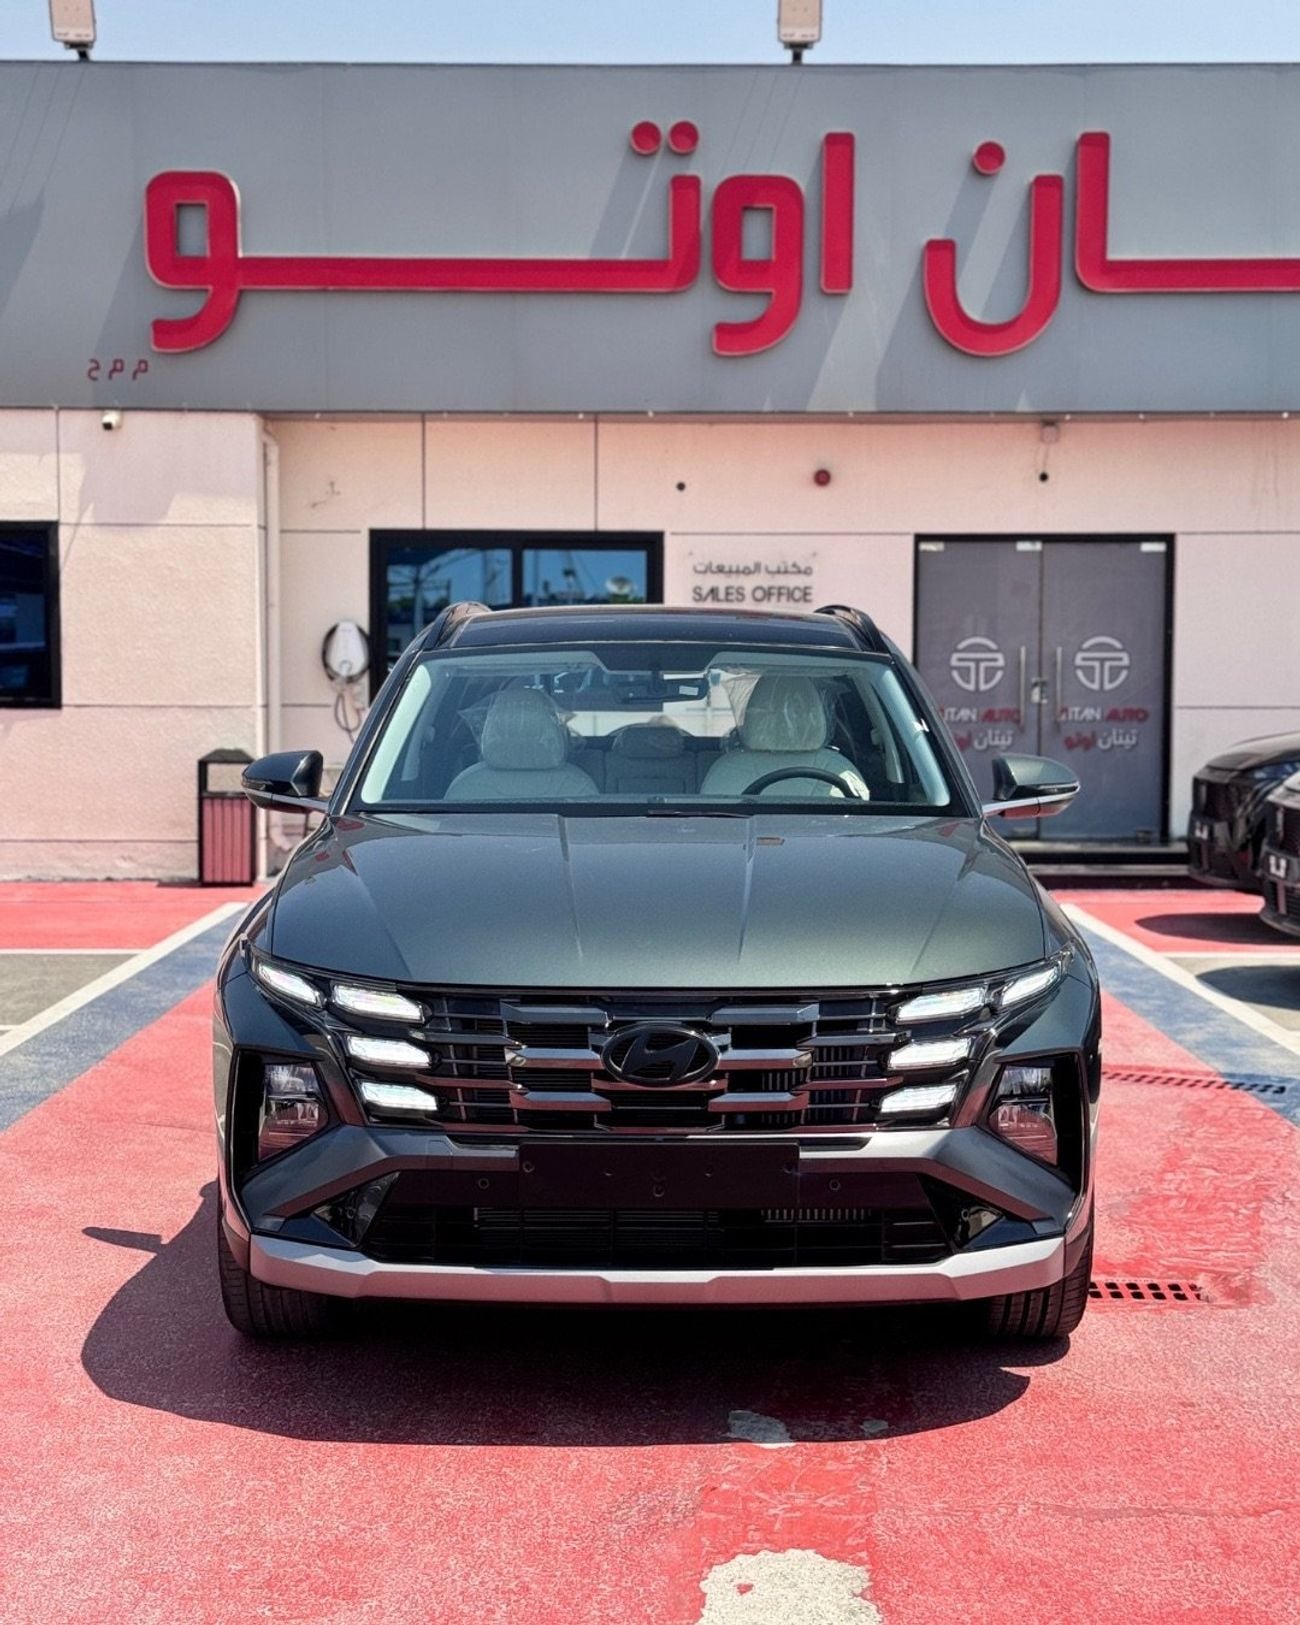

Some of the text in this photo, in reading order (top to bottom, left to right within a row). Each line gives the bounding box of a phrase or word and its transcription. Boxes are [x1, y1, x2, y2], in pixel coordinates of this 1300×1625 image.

[145, 120, 1300, 358] ان اوتو
[692, 560, 814, 578] مكتب المبيعات
[692, 585, 814, 603] SALES OFFICE
